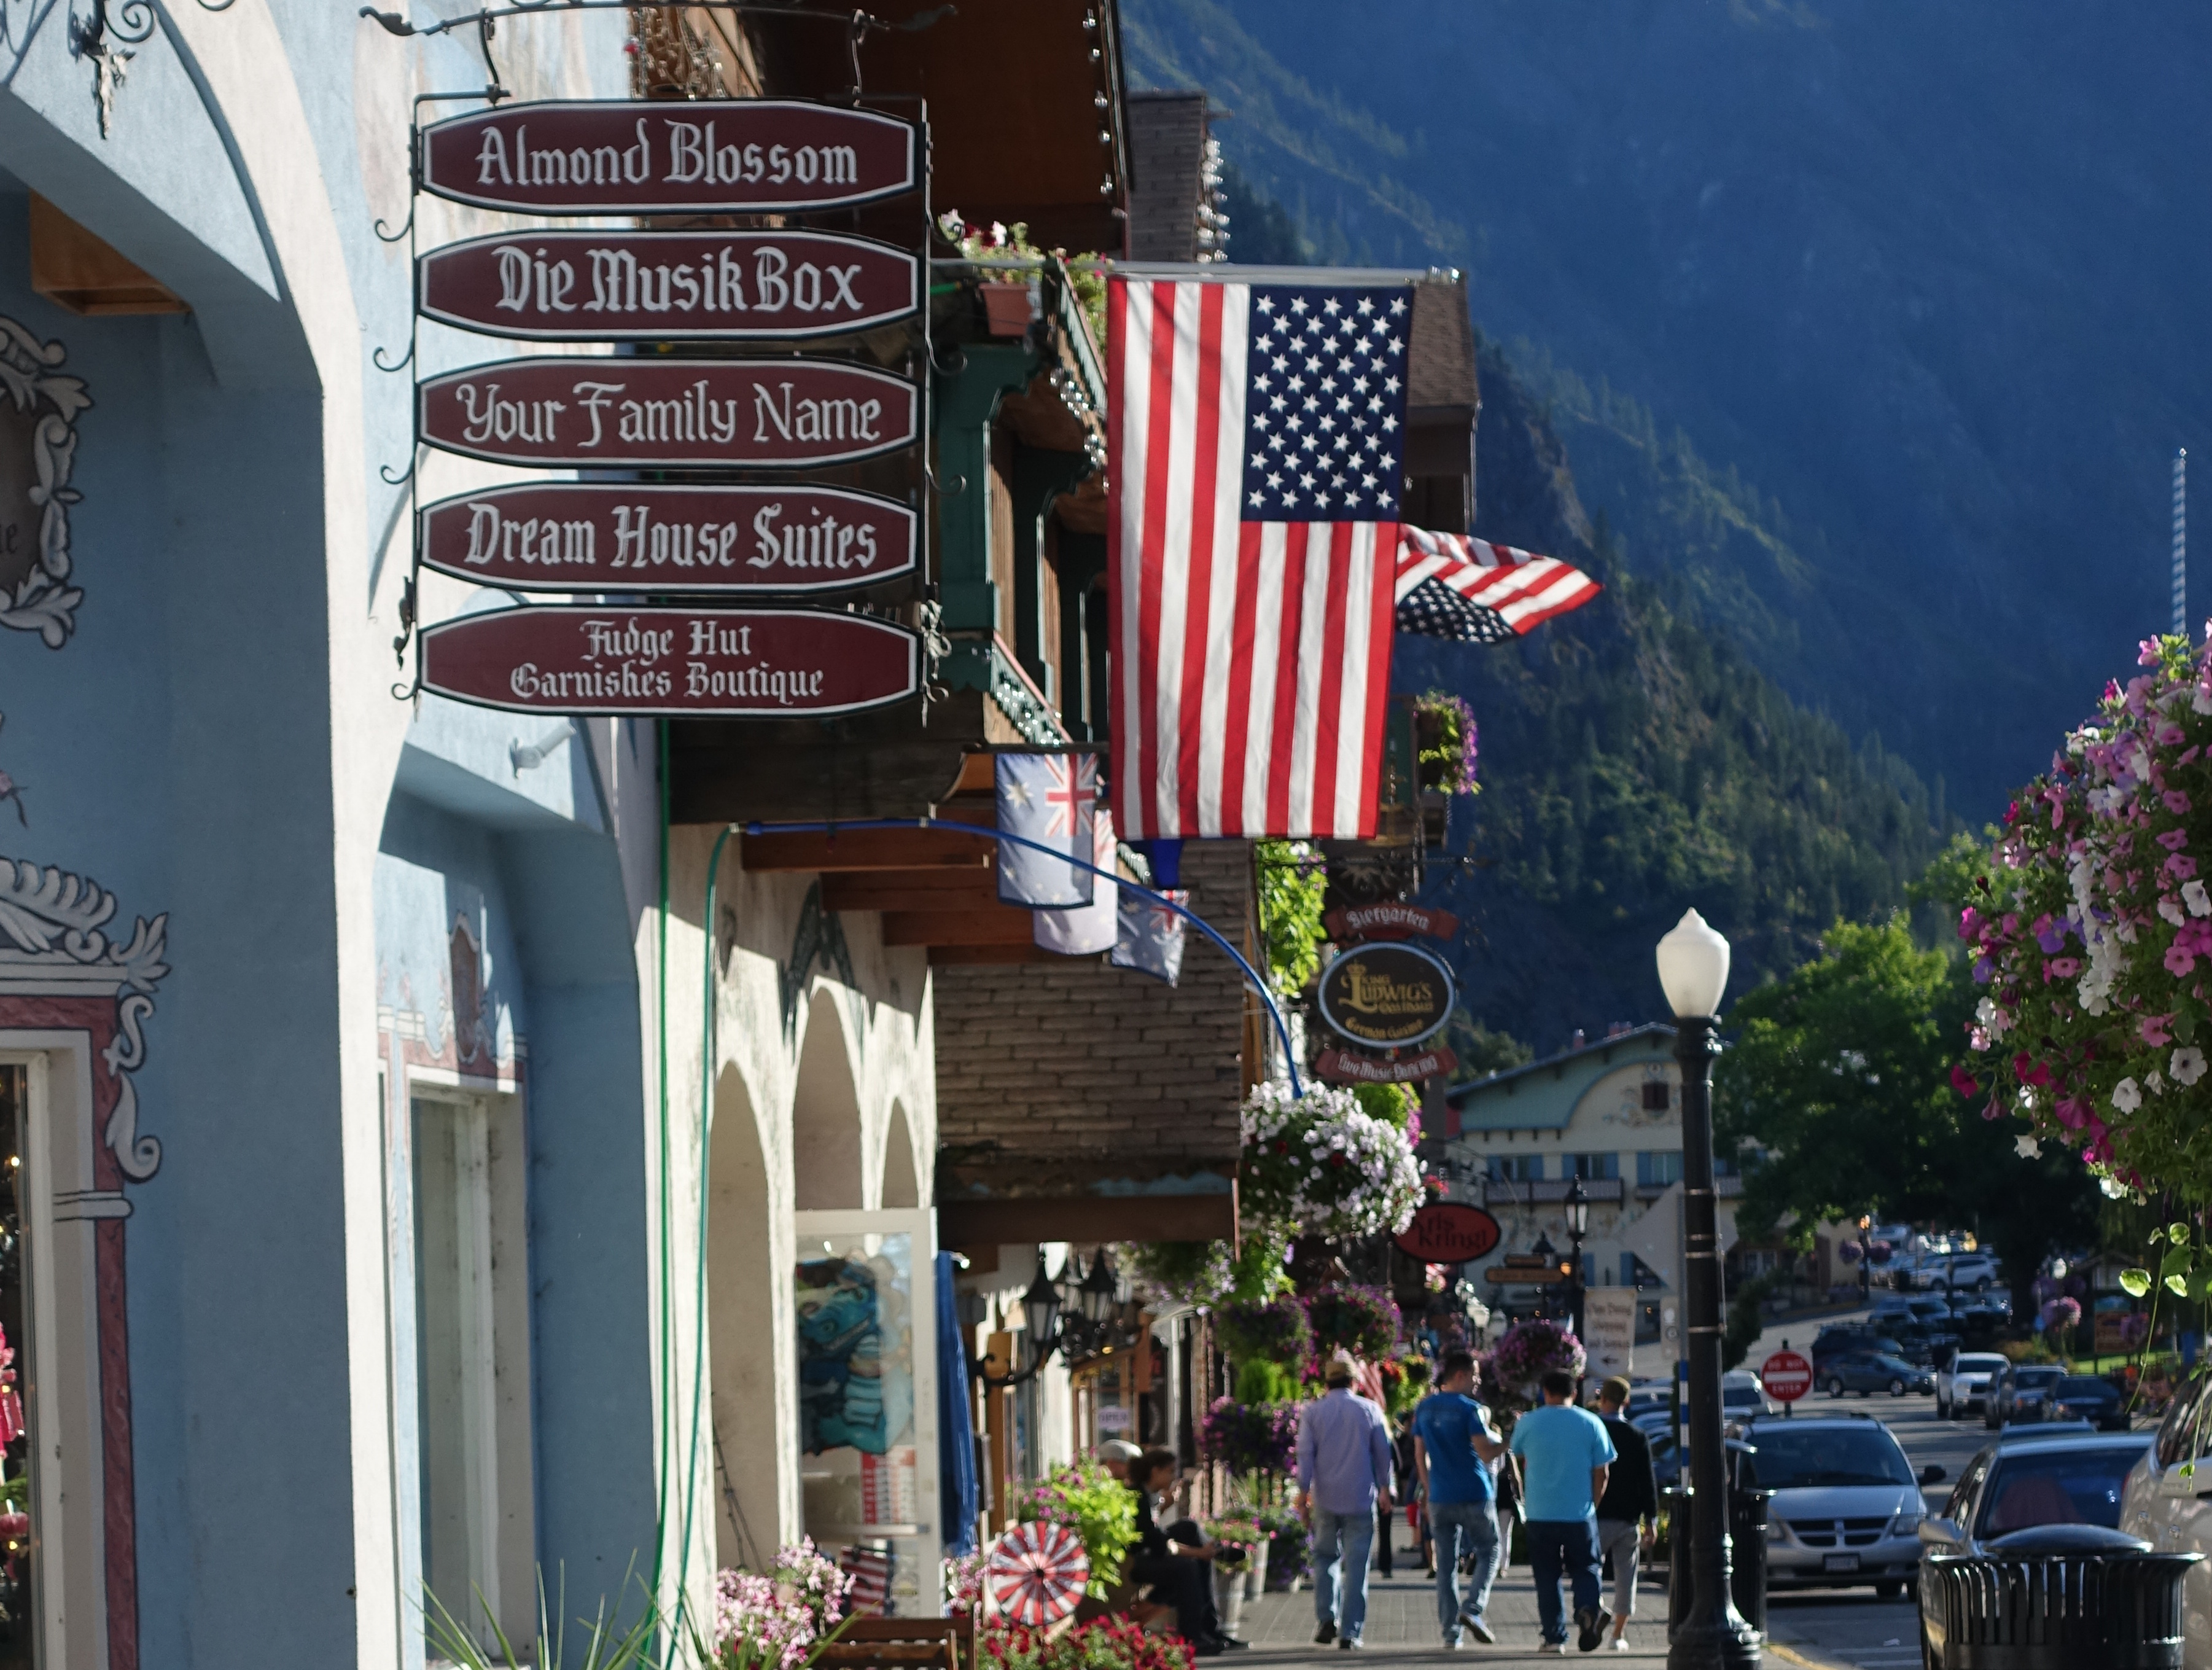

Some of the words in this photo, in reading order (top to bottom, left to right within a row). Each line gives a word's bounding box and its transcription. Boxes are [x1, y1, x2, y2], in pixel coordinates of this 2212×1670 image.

[476, 117, 650, 185] Almond
[663, 119, 859, 184] Blossom
[491, 246, 576, 313] Die
[583, 246, 747, 312] Musik
[752, 246, 865, 312] Box
[456, 383, 567, 444] Your
[573, 380, 737, 447] Family
[753, 381, 881, 443] Name
[464, 502, 597, 565] Dream
[610, 505, 738, 568] House
[746, 502, 878, 569] Suites
[580, 617, 674, 665] Fudge
[687, 620, 752, 655] Hut
[510, 661, 672, 700] Garnishes
[684, 661, 824, 706] Boutique
[1346, 907, 1430, 931] Biergarten
[1768, 1359, 1781, 1370] DO
[1786, 1359, 1804, 1370] NOT
[1772, 1383, 1801, 1394] ENTER
